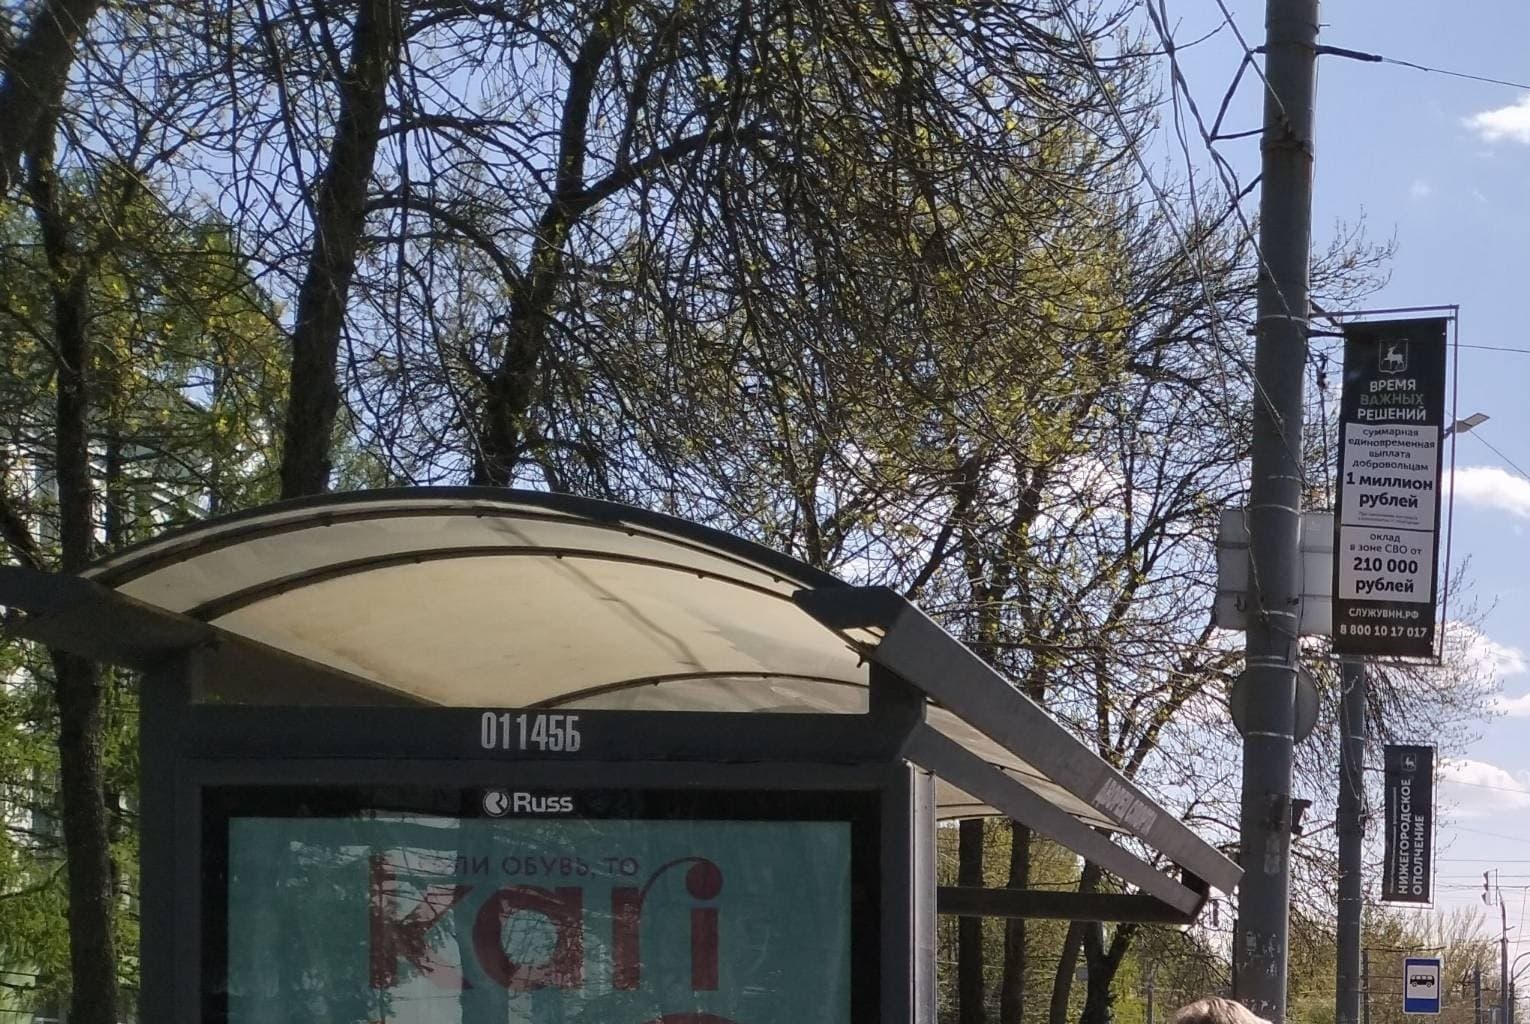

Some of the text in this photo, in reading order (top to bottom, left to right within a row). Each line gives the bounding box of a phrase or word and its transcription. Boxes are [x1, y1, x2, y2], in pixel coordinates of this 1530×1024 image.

[1369, 379, 1416, 392] ВРЕМЯ
[1360, 393, 1424, 406] ВАЖНЫХ
[1357, 406, 1426, 421] РЕШЕНИЙ
[1363, 429, 1419, 437] суммарная
[1369, 450, 1411, 458] выплата
[1352, 460, 1429, 471] добровольцам
[1346, 472, 1433, 490] 1 миллион
[1359, 492, 1418, 508] рублей
[1370, 533, 1400, 542] оклад
[1385, 544, 1407, 554] СВО
[1353, 556, 1418, 574] 210 000
[1355, 578, 1414, 594] рублей
[1340, 624, 1427, 638] 8 800 10 17 017
[513, 792, 574, 812] Russ
[1398, 778, 1411, 895] НИЖЕГОРОДСКОЕ
[1412, 814, 1424, 895] ОПОЛЧЕНИЕ
[604, 857, 640, 876] ТО
[369, 855, 724, 991] kari
